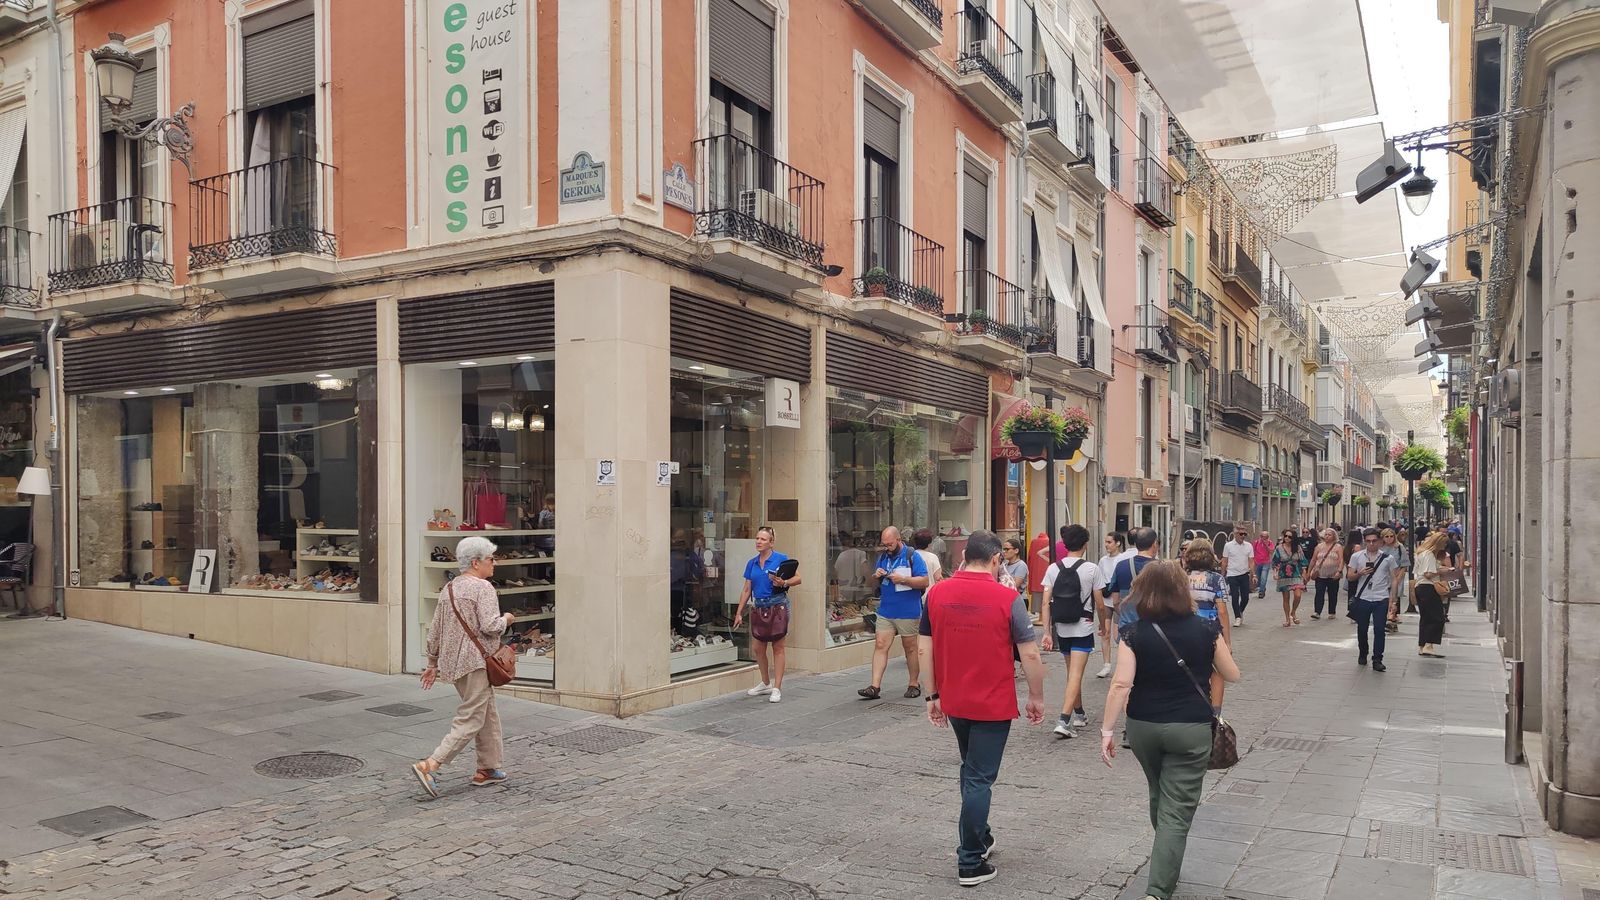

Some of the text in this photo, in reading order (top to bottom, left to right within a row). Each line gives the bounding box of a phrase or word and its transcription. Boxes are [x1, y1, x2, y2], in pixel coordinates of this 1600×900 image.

[476, 0, 517, 31] guest
[470, 30, 512, 52] house
[566, 170, 599, 182] MARQUES
[564, 184, 602, 199] GERONA
[777, 411, 799, 421] ROSSELLI
